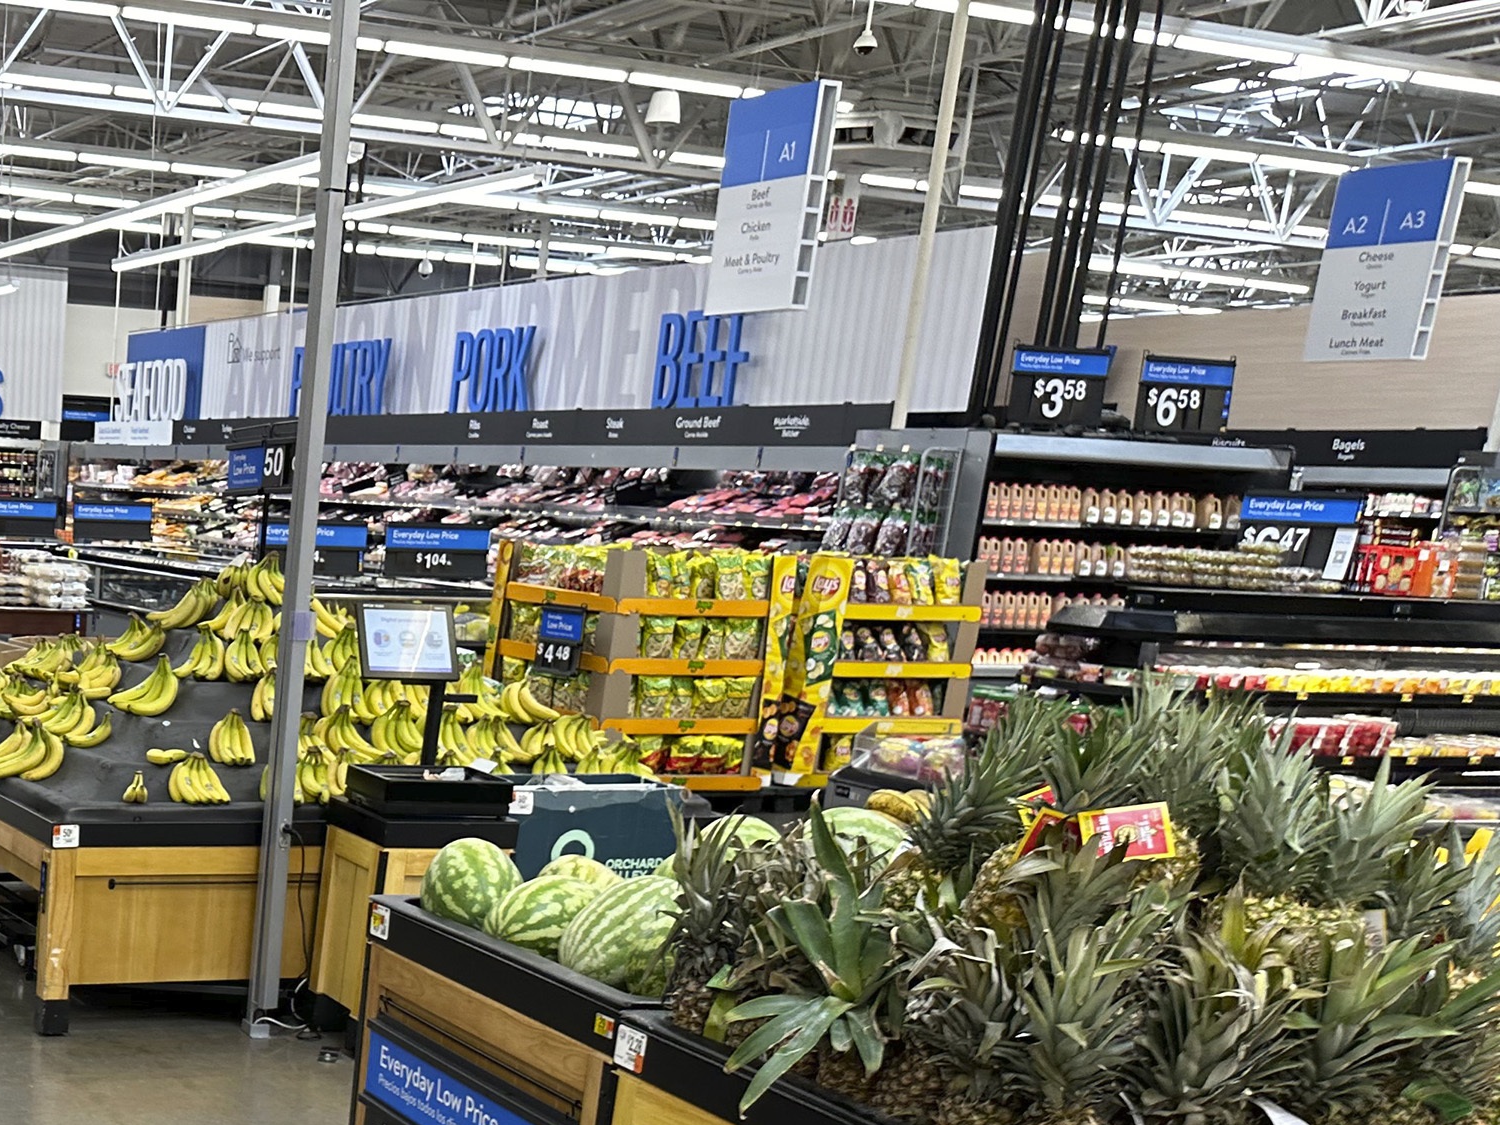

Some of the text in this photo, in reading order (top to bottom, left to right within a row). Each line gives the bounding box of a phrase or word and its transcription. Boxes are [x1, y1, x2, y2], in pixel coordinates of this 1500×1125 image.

[778, 140, 797, 163] A1
[751, 186, 771, 201] Beef
[740, 220, 772, 235] Chicken
[1342, 210, 1426, 236] A2 A3
[724, 252, 780, 268] Meat & Poultry
[1358, 251, 1395, 263] Cheese
[1354, 280, 1387, 295] Yogurt
[1341, 308, 1387, 320] Breakfast
[1329, 337, 1384, 349] Lunch Meat
[651, 310, 750, 410] BEEF
[1020, 353, 1081, 366] Everyday Low Price
[449, 325, 537, 414] PORK
[1149, 363, 1206, 376] Everyday Low Price
[289, 338, 392, 417] PLTRY
[114, 358, 187, 421] SEAFOOD
[7, 423, 30, 431] Cheese
[531, 418, 549, 429] Roast
[605, 417, 624, 430] Steak
[676, 415, 722, 430] Ground Beef
[1332, 438, 1365, 453] Bagels
[263, 447, 284, 476] 50
[19, 503, 34, 511] Price
[103, 505, 114, 514] Low
[115, 505, 129, 514] Price
[1249, 498, 1285, 513] Everyday
[1286, 500, 1302, 511] Low
[1304, 501, 1325, 512] Price
[317, 526, 335, 537] Price
[392, 529, 459, 541] Everyday Low Price
[812, 574, 841, 596] Lay's
[605, 857, 664, 869] ORCHARD
[379, 1045, 435, 1101] Everyday
[437, 1080, 462, 1114] Low
[377, 1073, 400, 1096] Precios
[401, 1086, 418, 1107] bajos
[418, 1095, 436, 1117] todos
[435, 1106, 447, 1122] los
